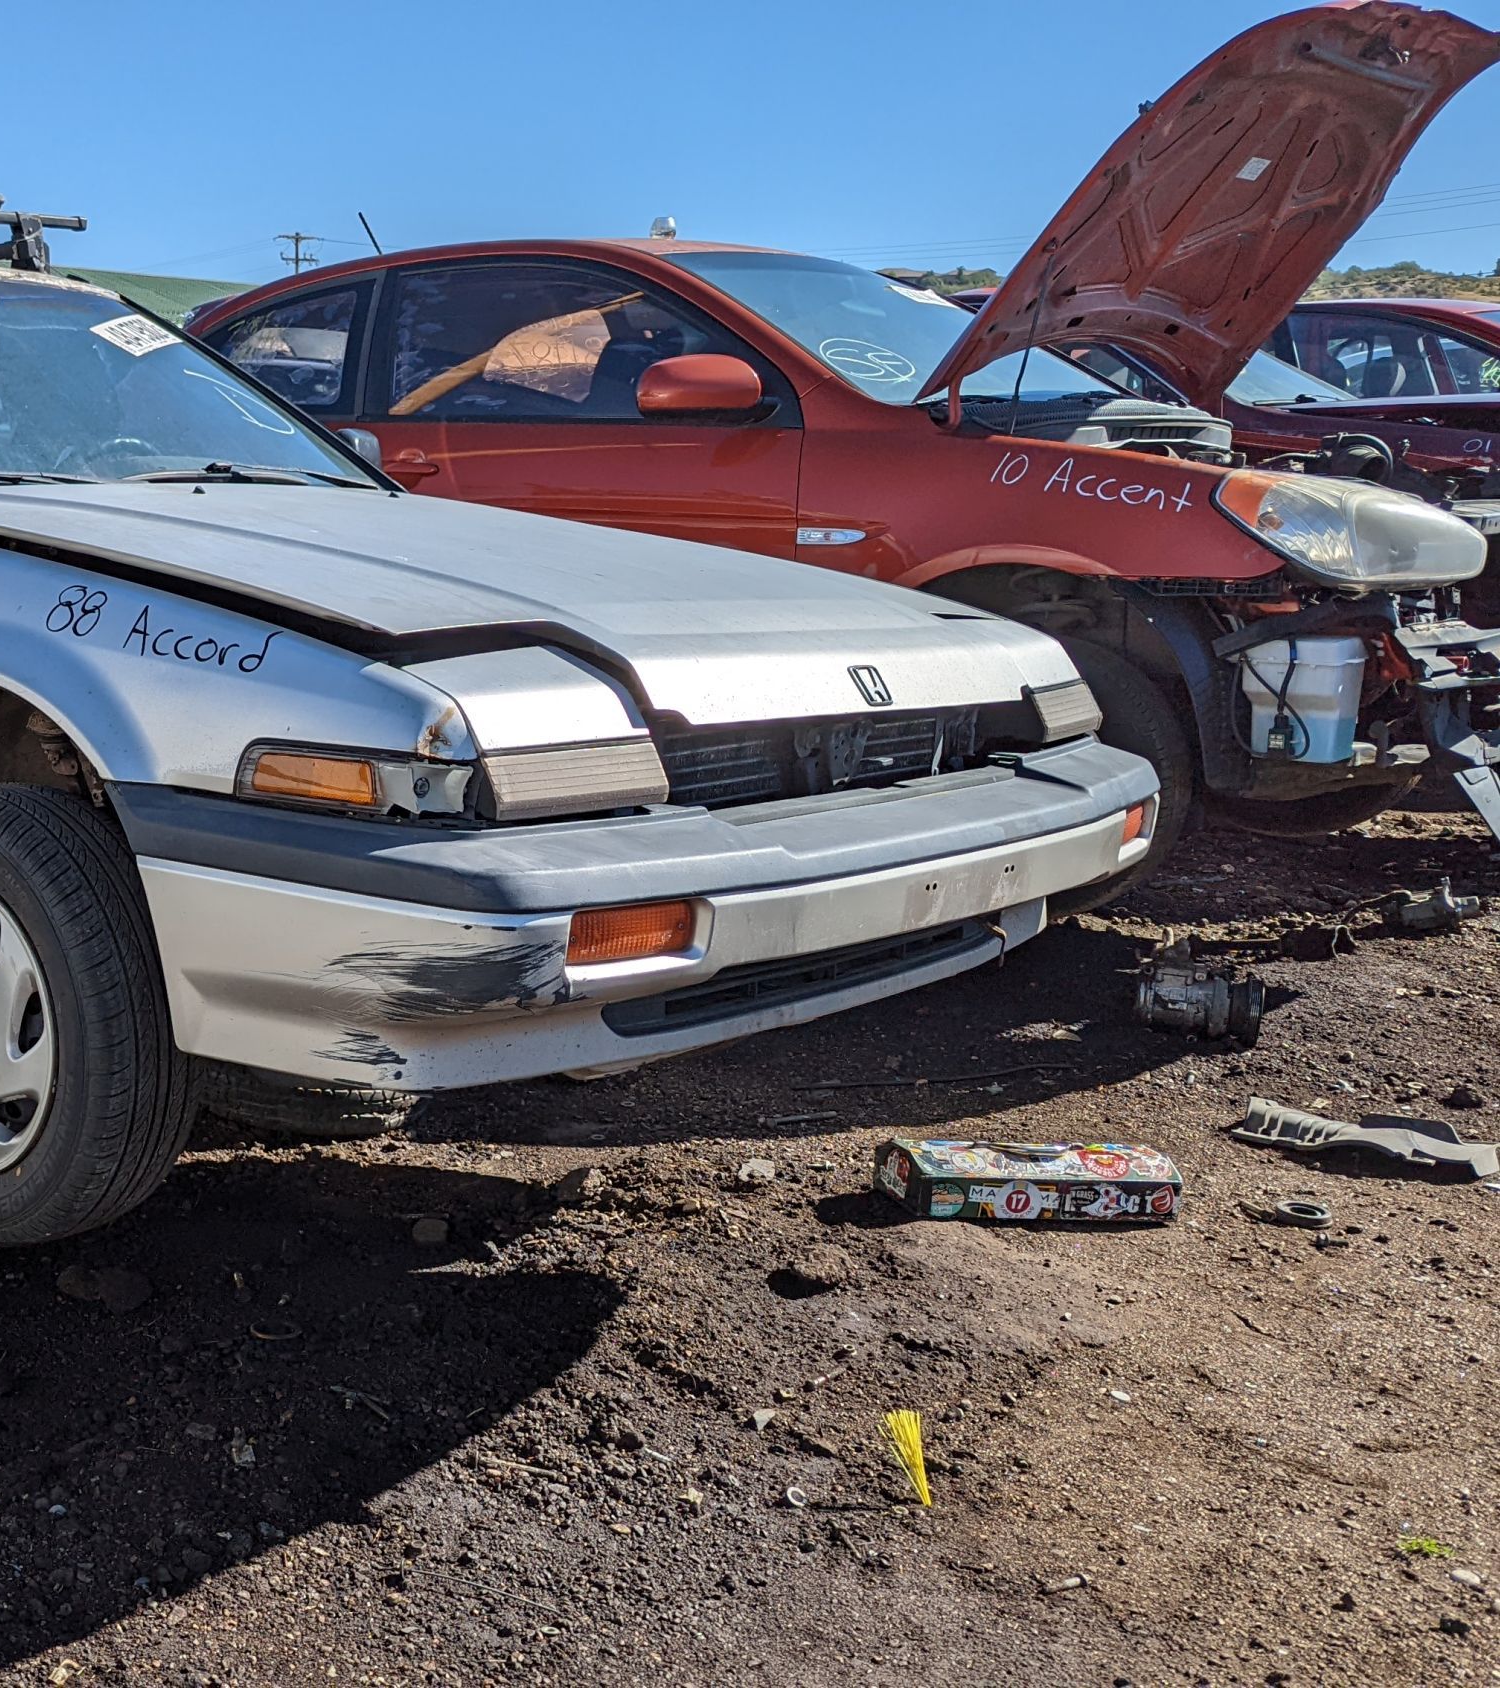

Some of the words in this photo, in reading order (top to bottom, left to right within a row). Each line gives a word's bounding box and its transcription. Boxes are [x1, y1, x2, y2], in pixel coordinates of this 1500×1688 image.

[991, 452, 1029, 485] 10
[1043, 458, 1193, 512] Accent
[46, 585, 108, 637] 88
[123, 605, 285, 673] Accord
[1011, 1194, 1027, 1209] 17
